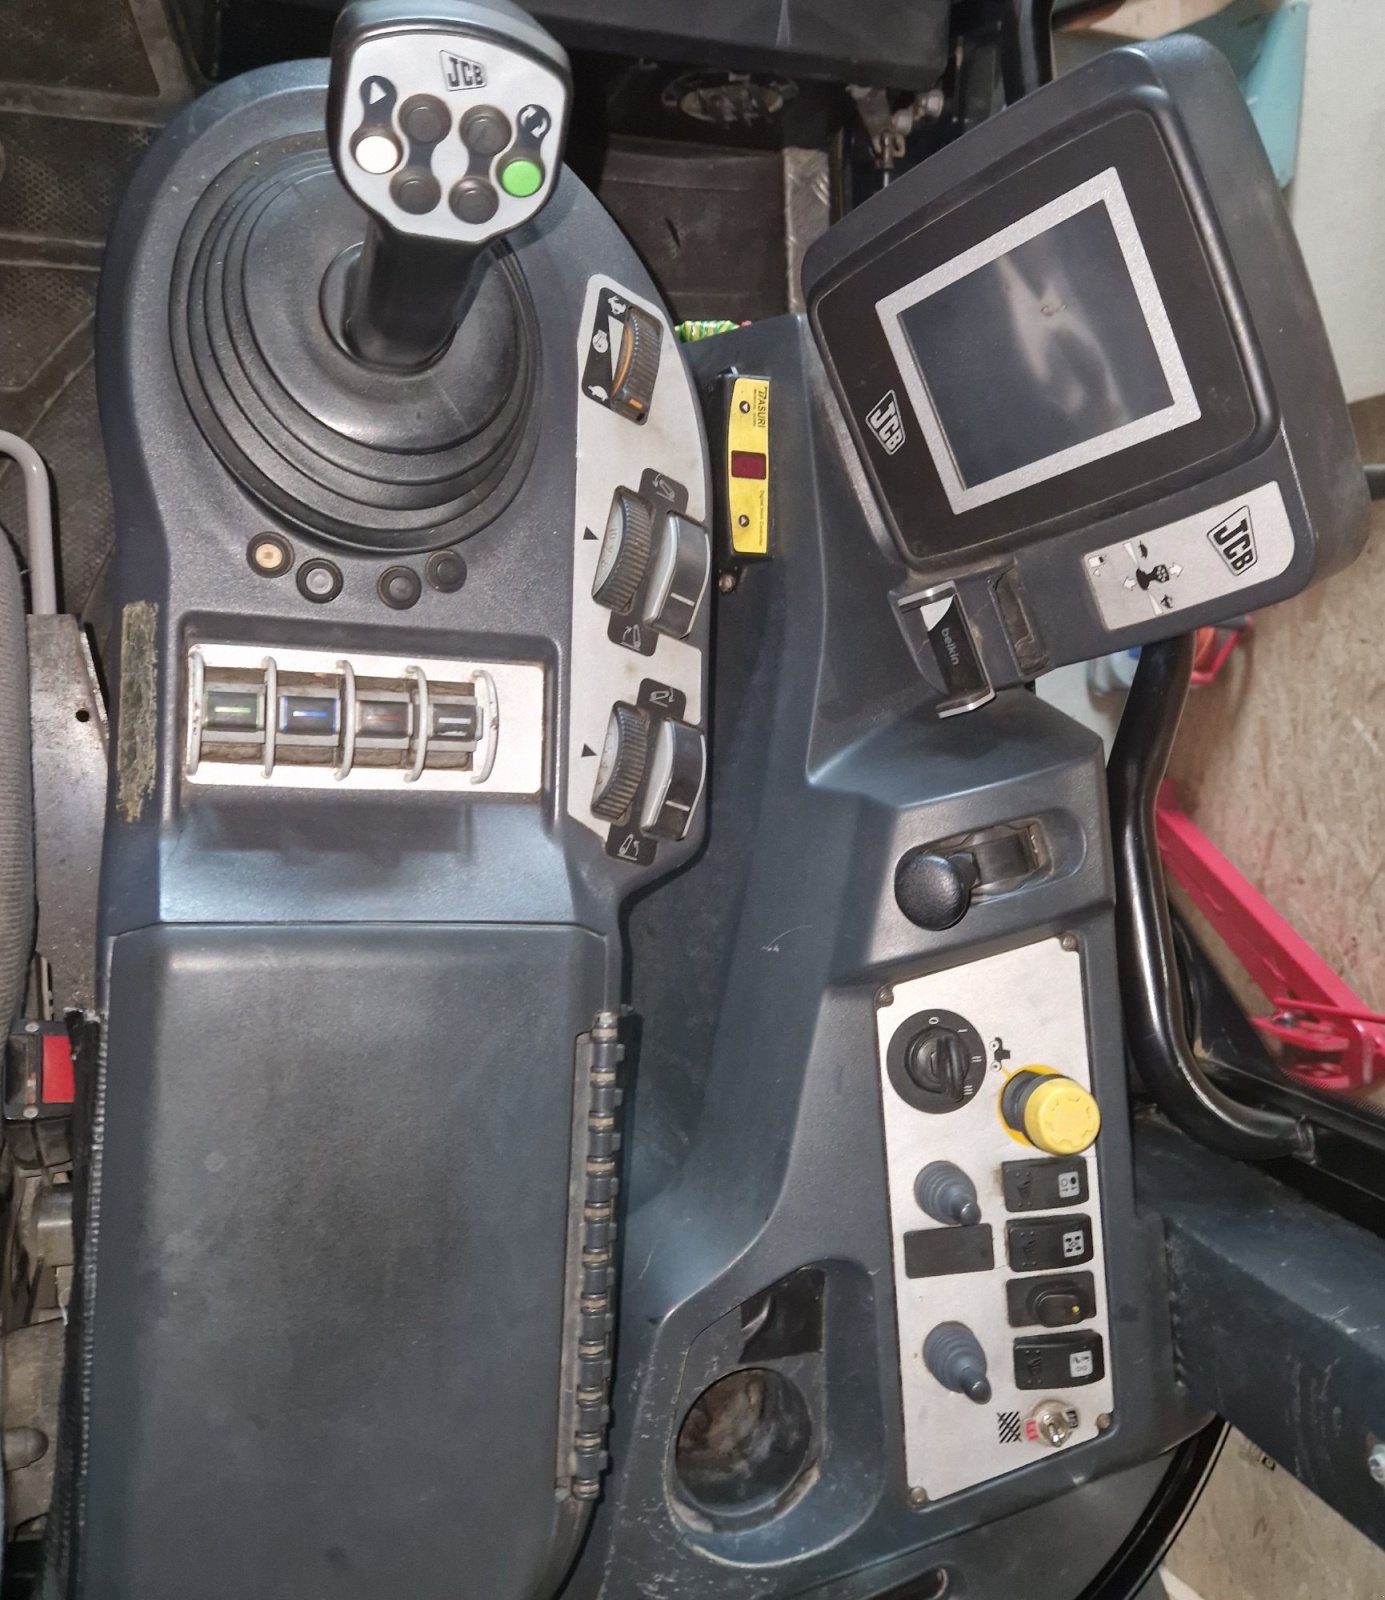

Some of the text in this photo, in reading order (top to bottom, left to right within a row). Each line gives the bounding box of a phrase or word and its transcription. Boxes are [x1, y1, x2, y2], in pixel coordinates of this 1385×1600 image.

[447, 56, 484, 88] JCB
[870, 400, 903, 451] JCB
[1213, 517, 1254, 571] JCB
[941, 627, 960, 666] belkin
